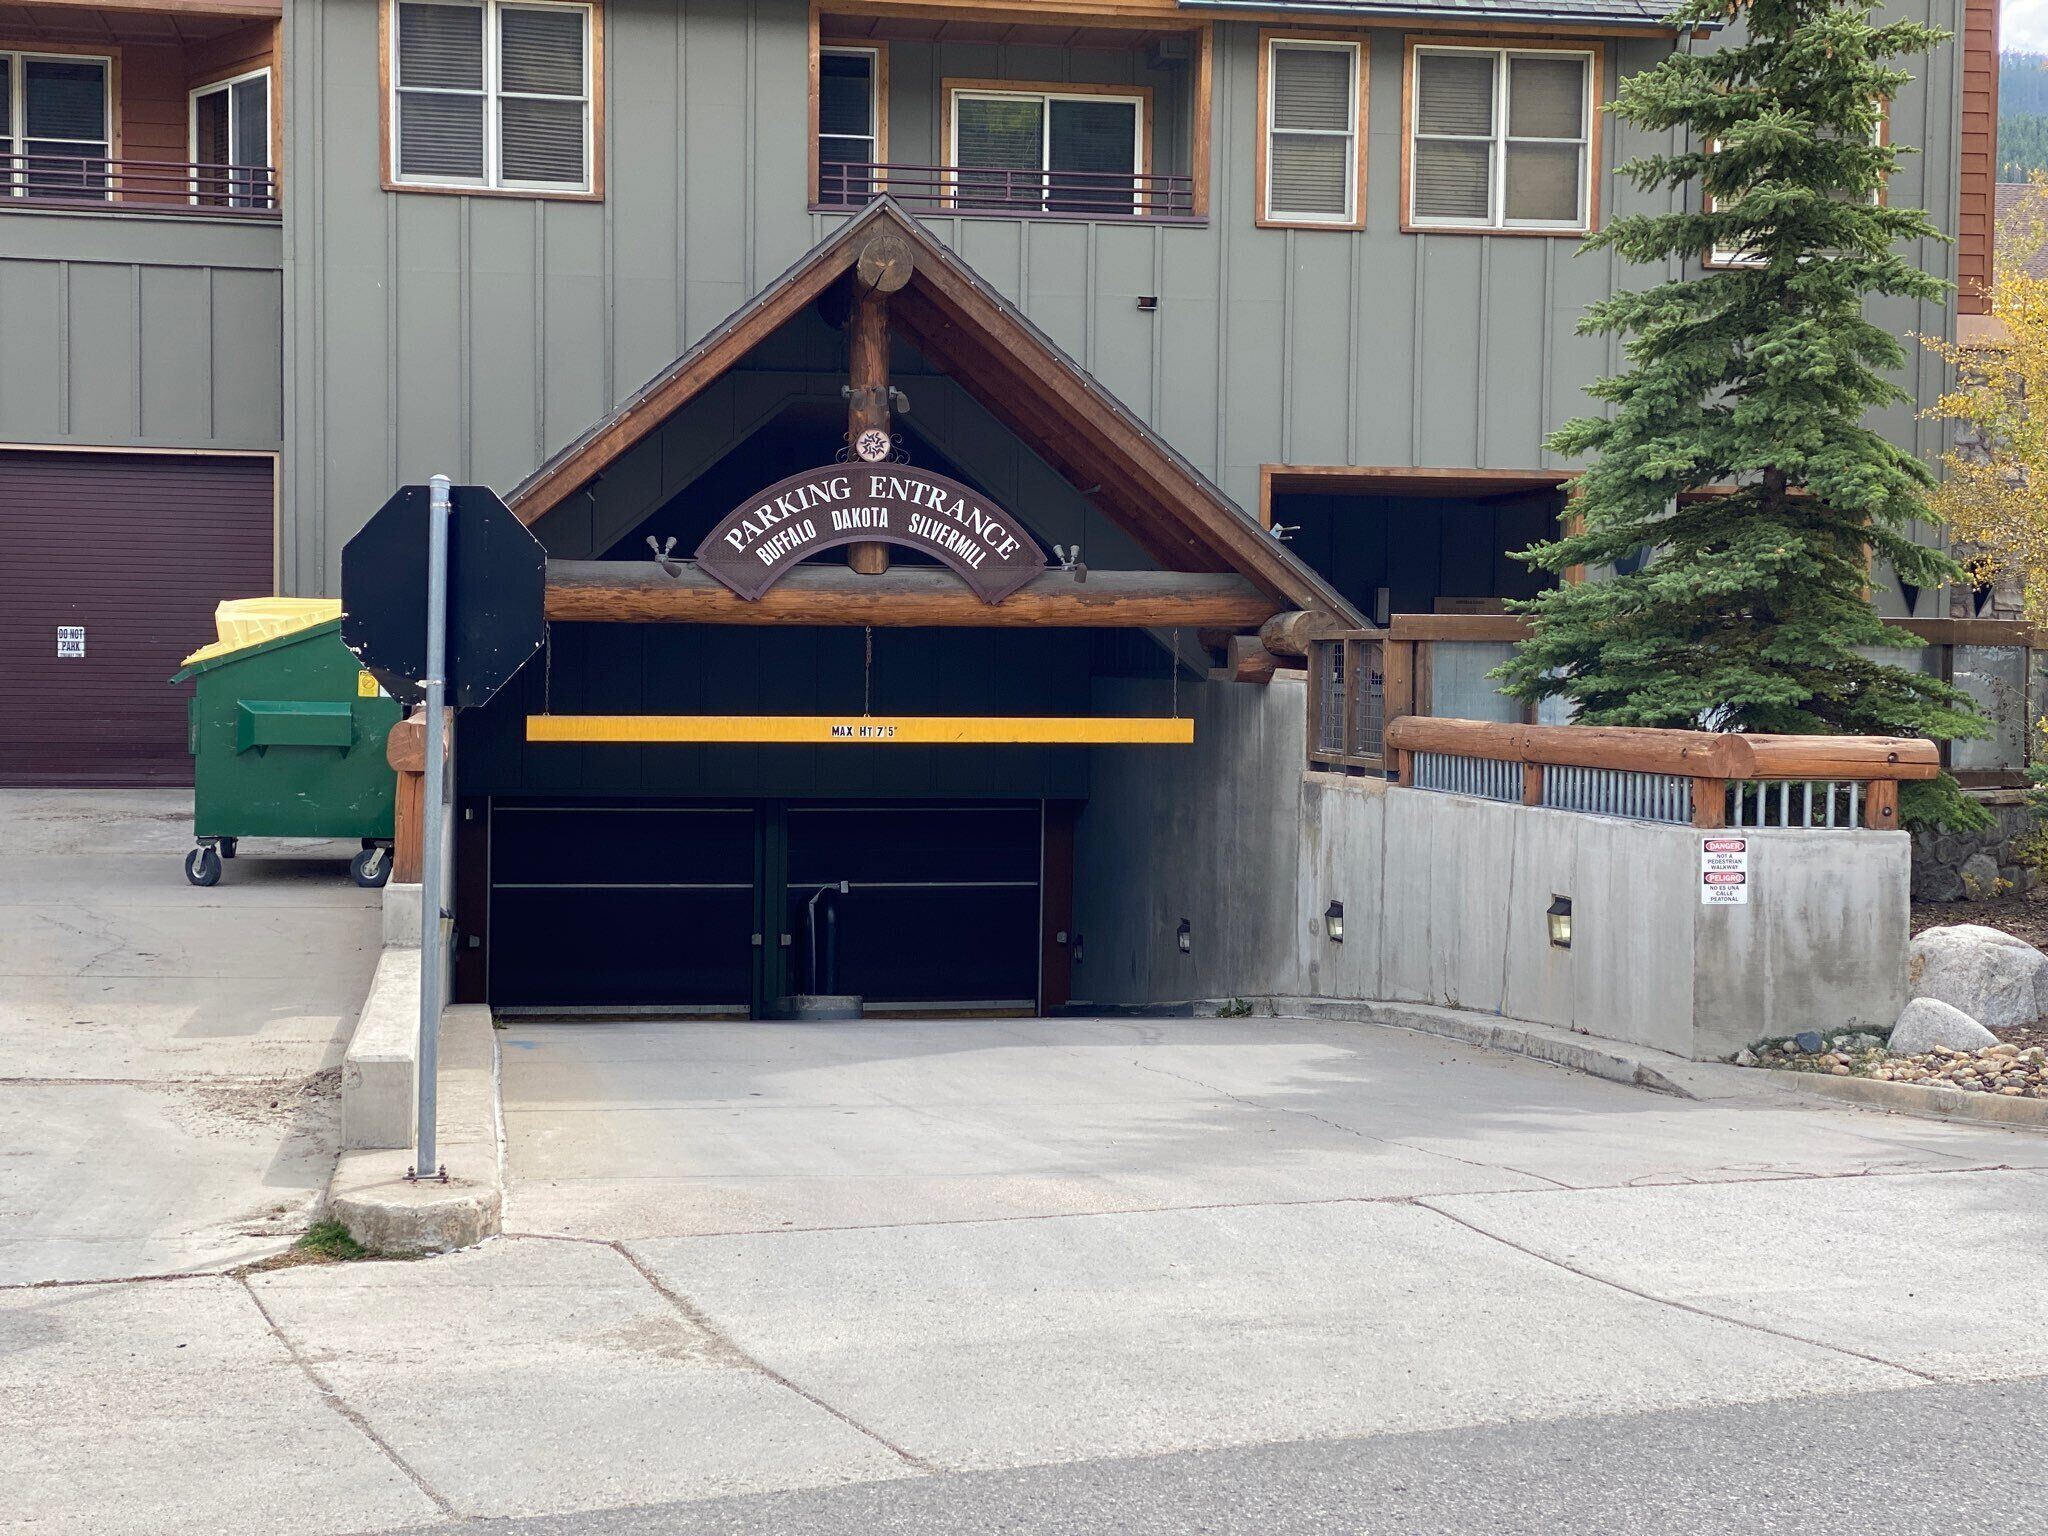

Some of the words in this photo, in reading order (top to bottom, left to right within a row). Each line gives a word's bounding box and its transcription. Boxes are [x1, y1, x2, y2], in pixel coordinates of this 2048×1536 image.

[724, 477, 851, 553] PARKING
[869, 475, 1021, 561] ENTRANCE
[755, 518, 817, 567] BUFFALO
[831, 506, 889, 532] DAKOTA
[908, 512, 987, 570] SILVERMILL
[59, 629, 68, 639] DO
[70, 629, 83, 639] NOT
[62, 641, 80, 651] PARK
[831, 726, 853, 736] MAX
[860, 726, 872, 736] HT
